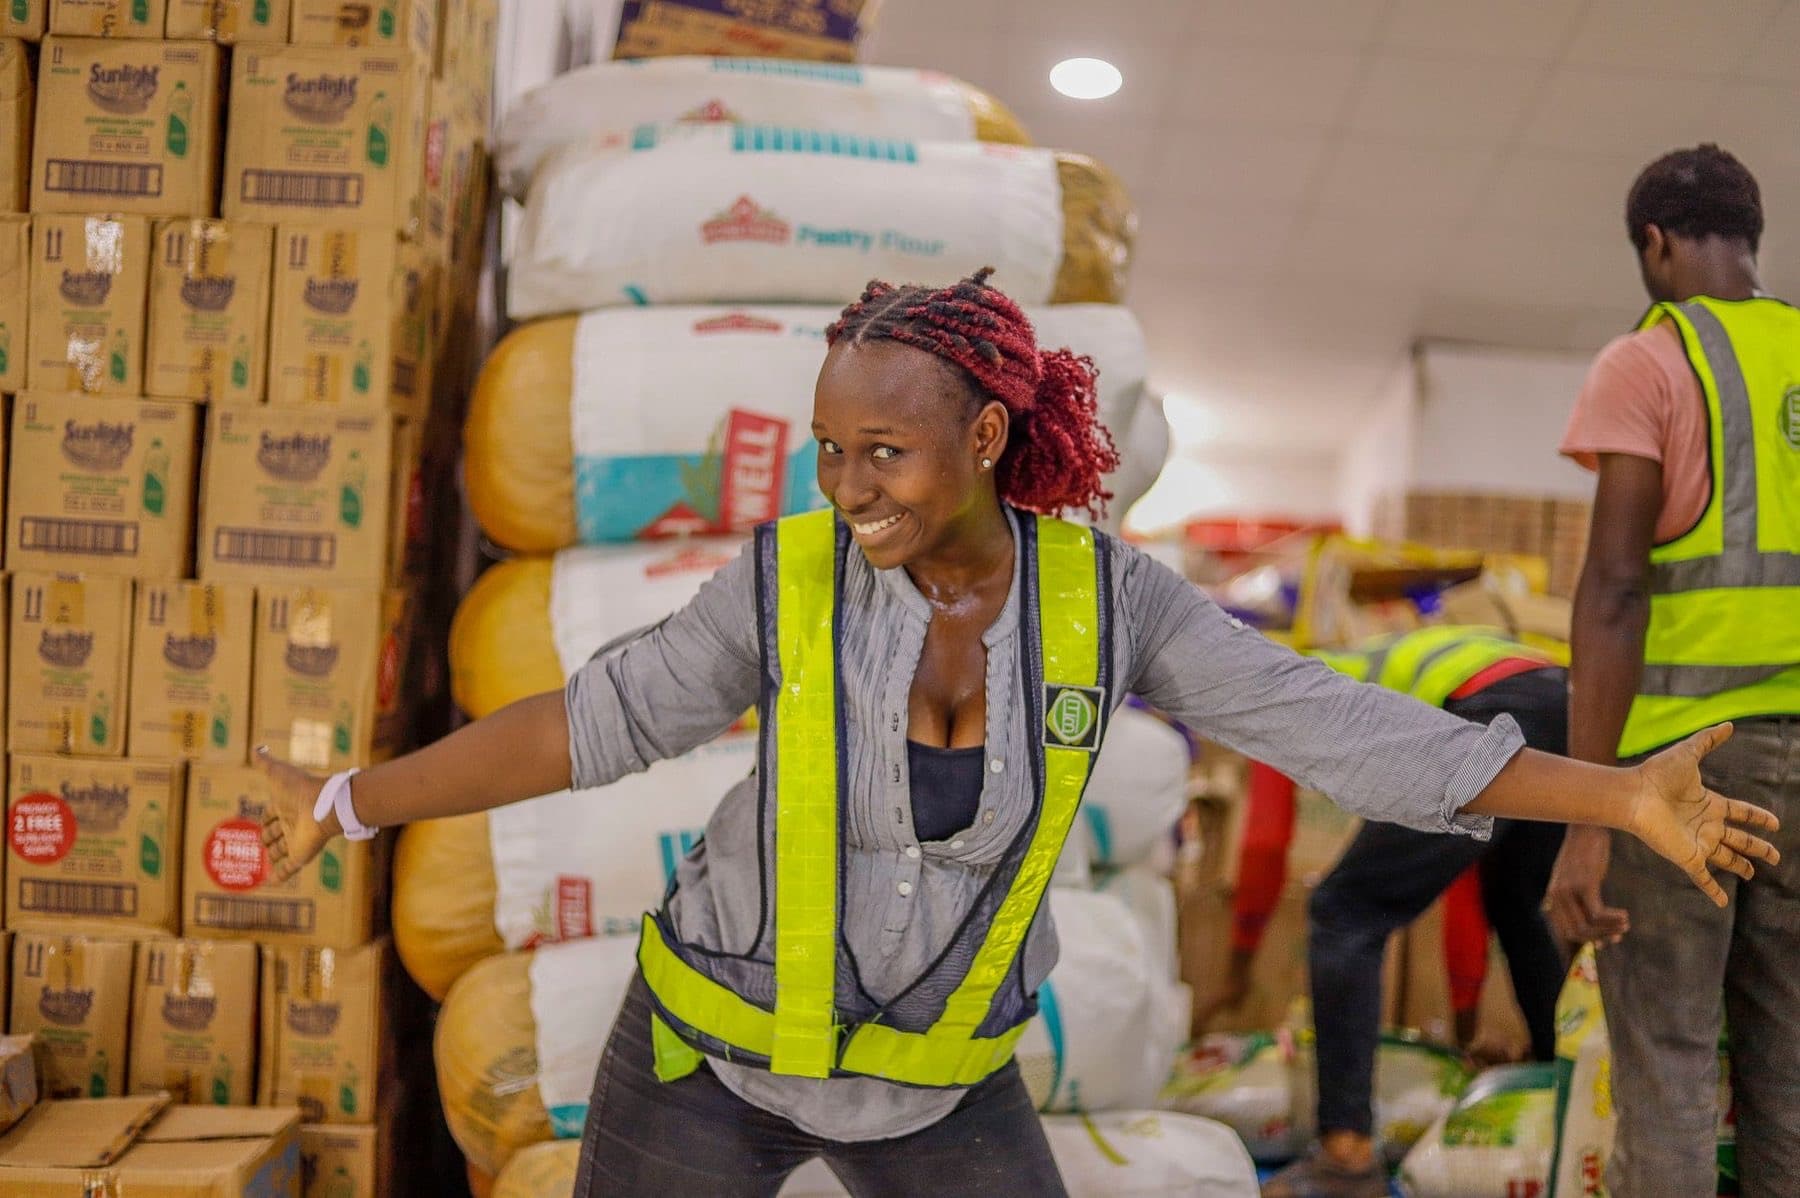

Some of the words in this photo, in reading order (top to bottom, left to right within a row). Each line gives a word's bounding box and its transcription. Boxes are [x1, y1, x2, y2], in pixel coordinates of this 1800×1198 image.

[90, 62, 160, 88] Sunlight
[798, 224, 872, 252] Pastry
[731, 423, 779, 522] WELL
